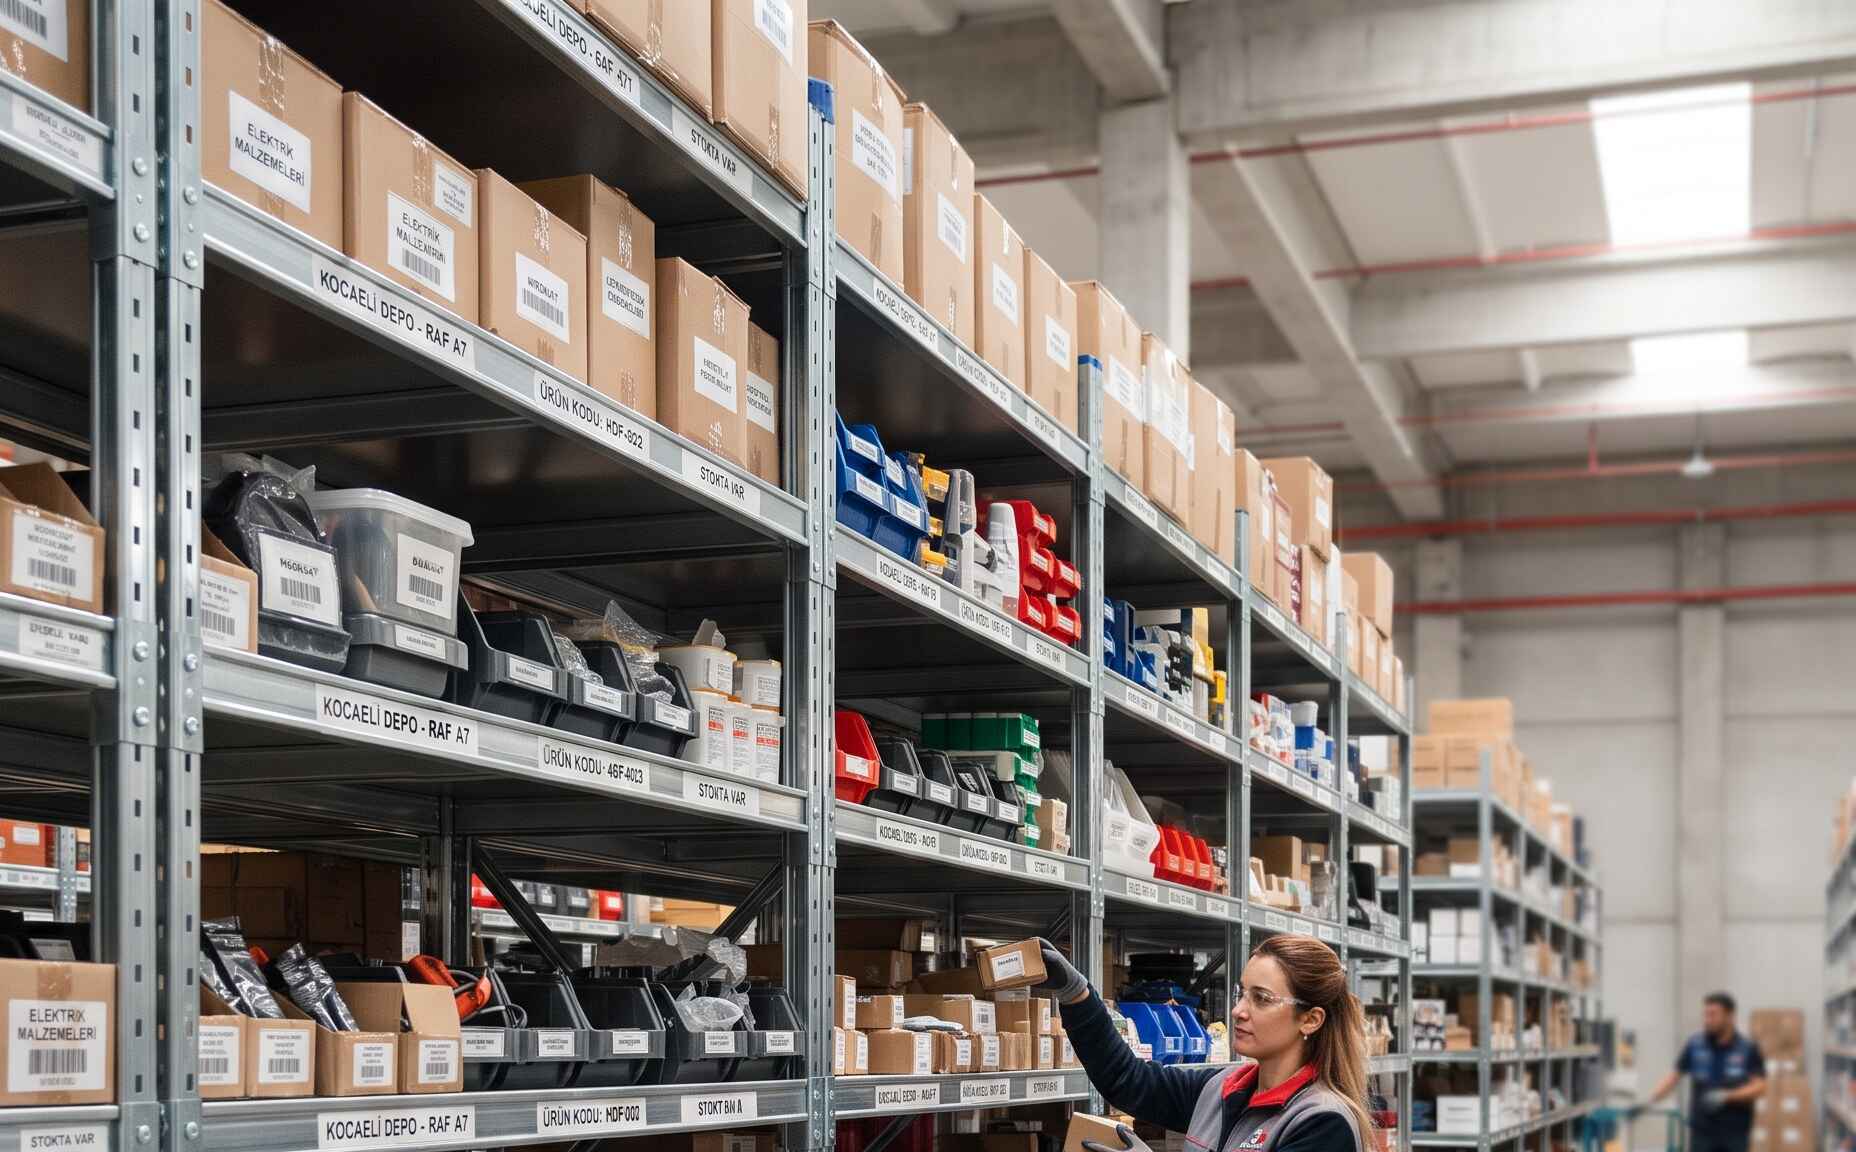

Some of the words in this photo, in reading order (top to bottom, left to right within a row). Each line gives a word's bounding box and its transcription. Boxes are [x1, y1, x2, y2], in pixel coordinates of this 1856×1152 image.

[559, 18, 588, 53] DEPO
[235, 137, 305, 186] MALZEMELERİ
[320, 271, 378, 314] KOCAELİ
[379, 302, 415, 332] DEPO
[425, 324, 450, 349] RAF
[453, 340, 467, 357] A7
[572, 400, 603, 430] KODU:
[323, 697, 381, 727] KOCAELİ
[384, 710, 418, 734] DEPO
[428, 719, 451, 741] RAF
[455, 727, 470, 745] A7
[543, 742, 572, 769] ÜRÜN
[731, 789, 746, 807] VAR
[326, 1115, 381, 1140] KOCAELİ
[384, 1121, 418, 1137] DEPO
[428, 1117, 451, 1134] RAF
[454, 1114, 469, 1133] A7
[543, 1106, 571, 1128] ÜRÜN
[573, 1108, 603, 1125] KODU:
[31, 1134, 71, 1149] STOKTA
[73, 1132, 95, 1145] VAR
